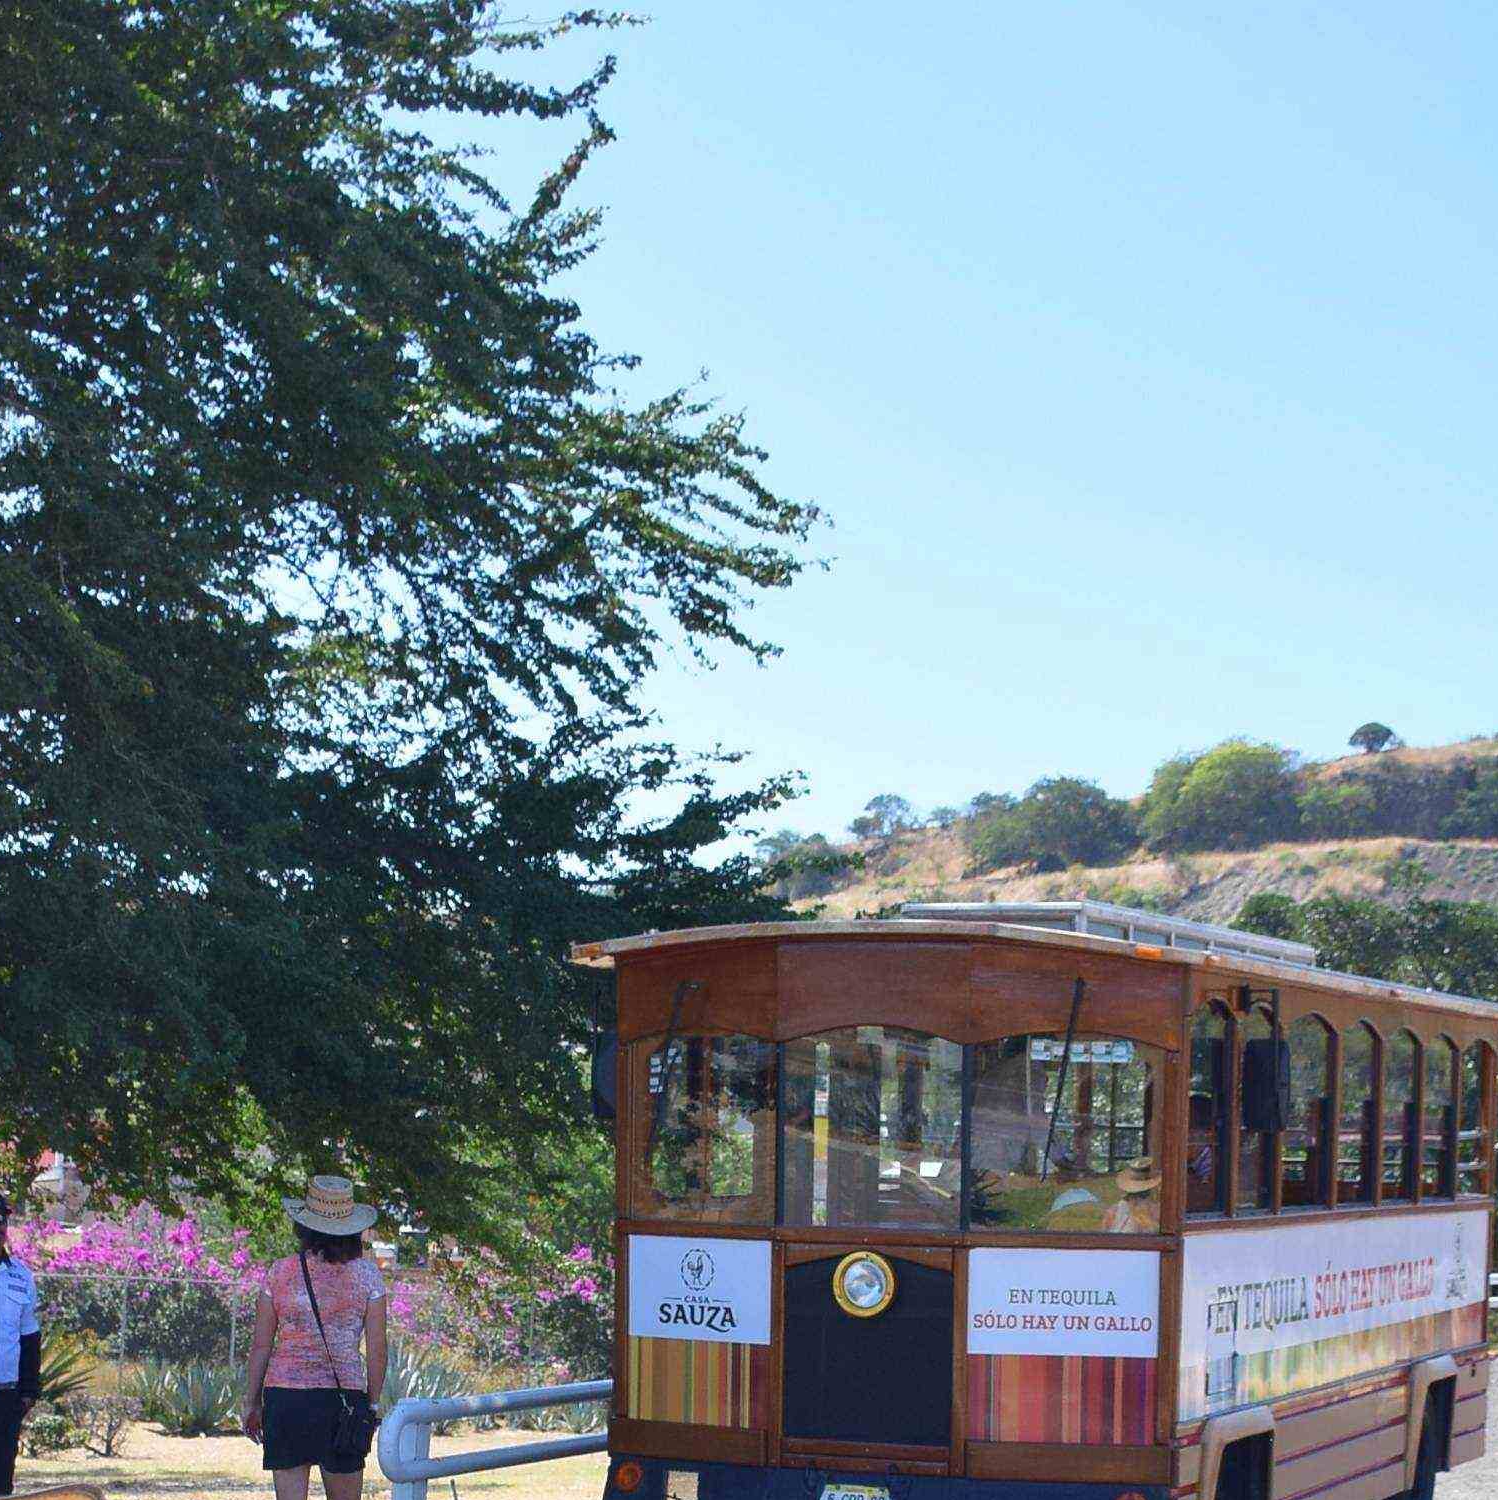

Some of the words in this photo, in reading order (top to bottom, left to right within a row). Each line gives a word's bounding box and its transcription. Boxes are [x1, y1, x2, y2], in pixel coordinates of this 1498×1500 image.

[1009, 1289, 1034, 1305] EN
[1038, 1290, 1117, 1307] TEQUILA
[1242, 1278, 1309, 1331] TEQUILA
[659, 1303, 737, 1333] SAUZA
[973, 1311, 1018, 1329] SÓLO
[1022, 1315, 1058, 1330] HAY
[1063, 1316, 1090, 1330] UN
[1094, 1317, 1153, 1332] GALLO
